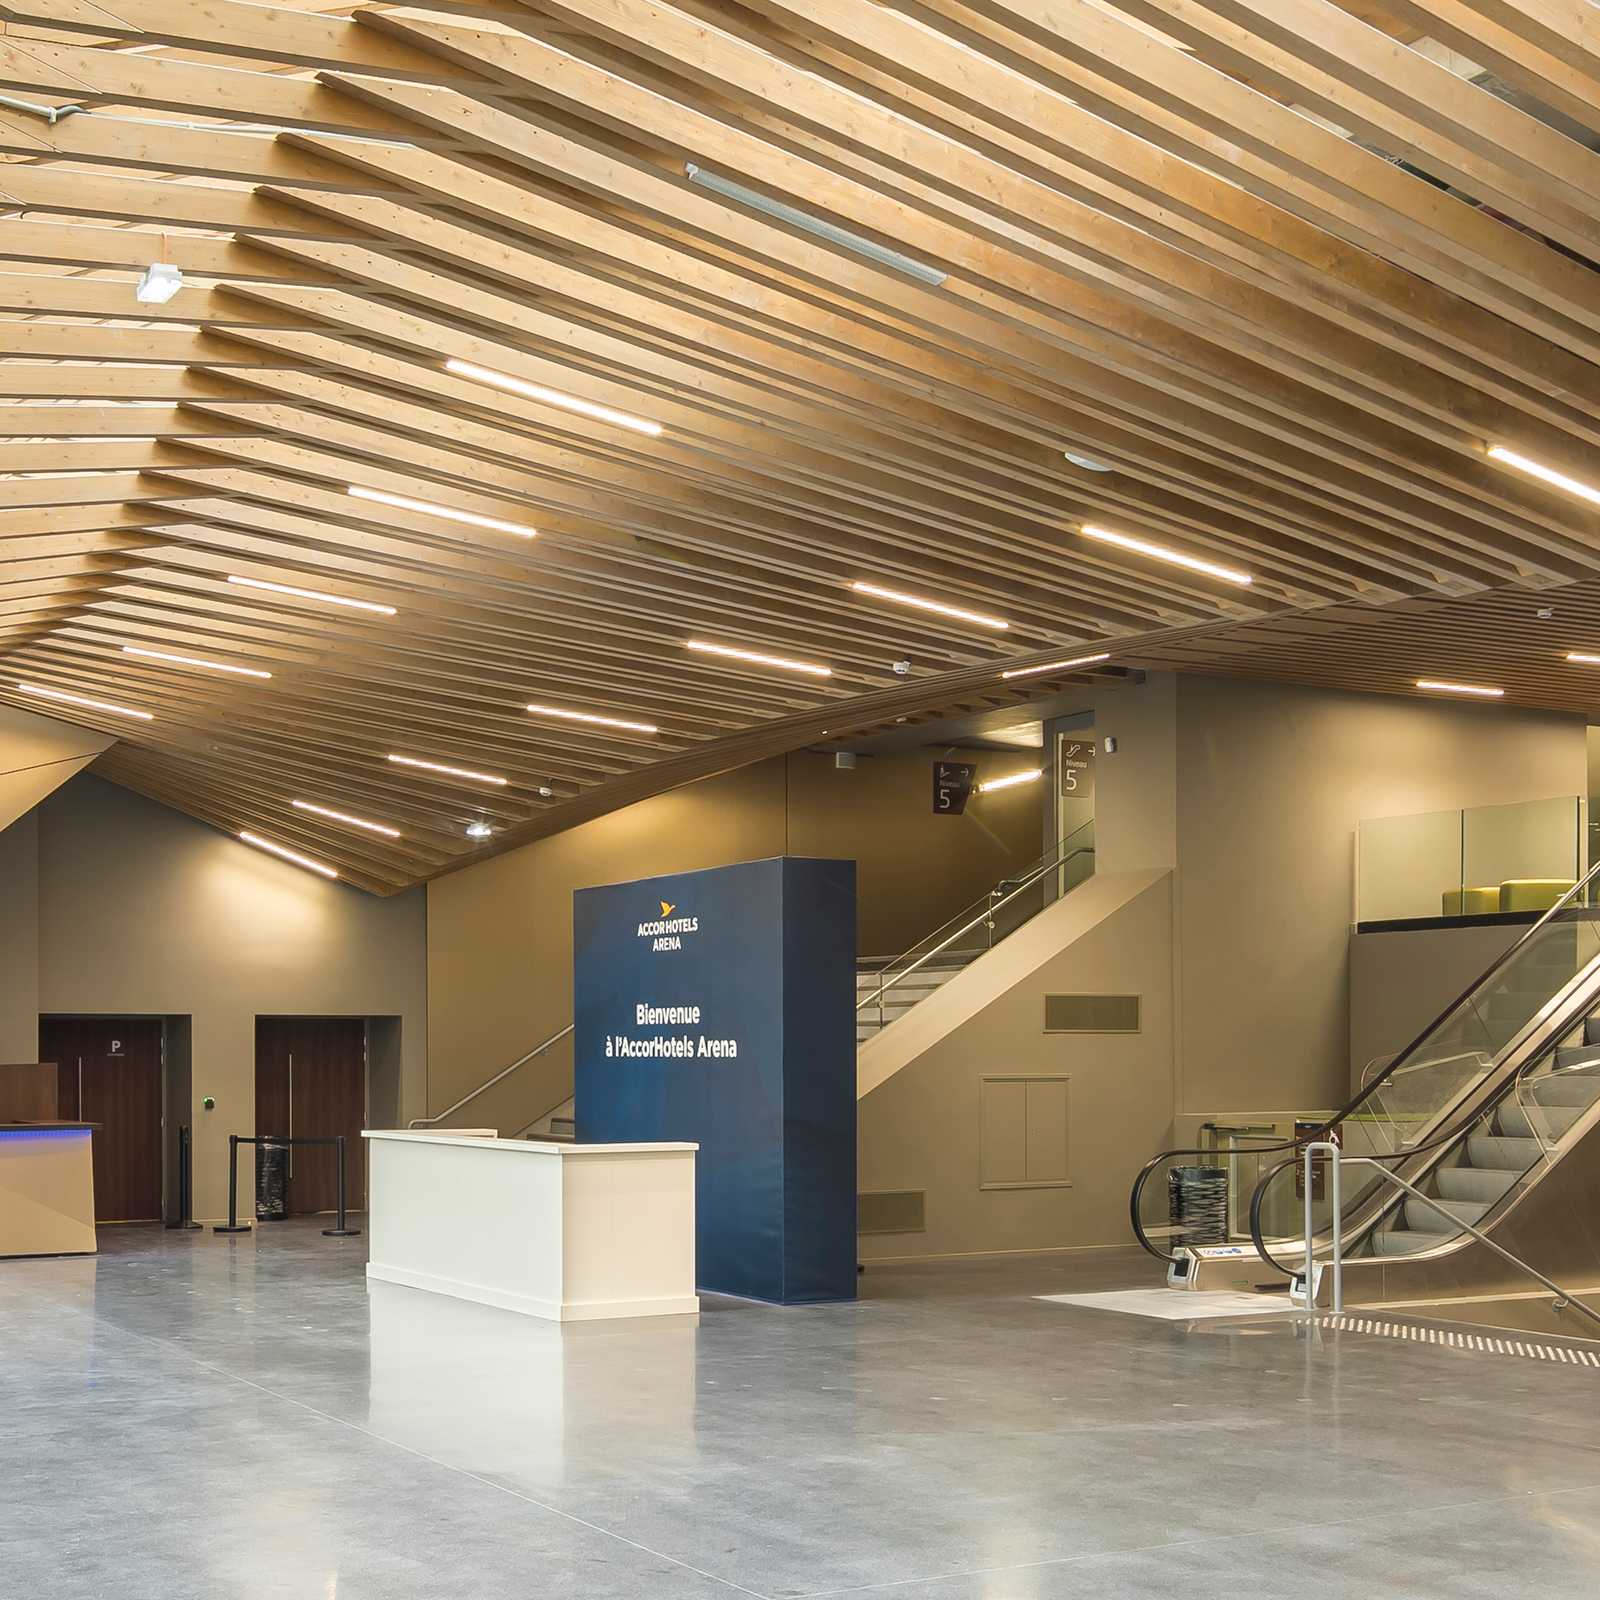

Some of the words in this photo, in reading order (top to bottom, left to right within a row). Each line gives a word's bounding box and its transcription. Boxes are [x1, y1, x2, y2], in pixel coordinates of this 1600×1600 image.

[1066, 769, 1077, 790] 5
[939, 789, 950, 809] 5
[637, 917, 699, 937] ACCORHOTELS
[652, 936, 682, 951] ARENA
[636, 1003, 701, 1025] Bienvenue
[605, 1035, 613, 1057] à
[697, 1035, 738, 1057] Arena
